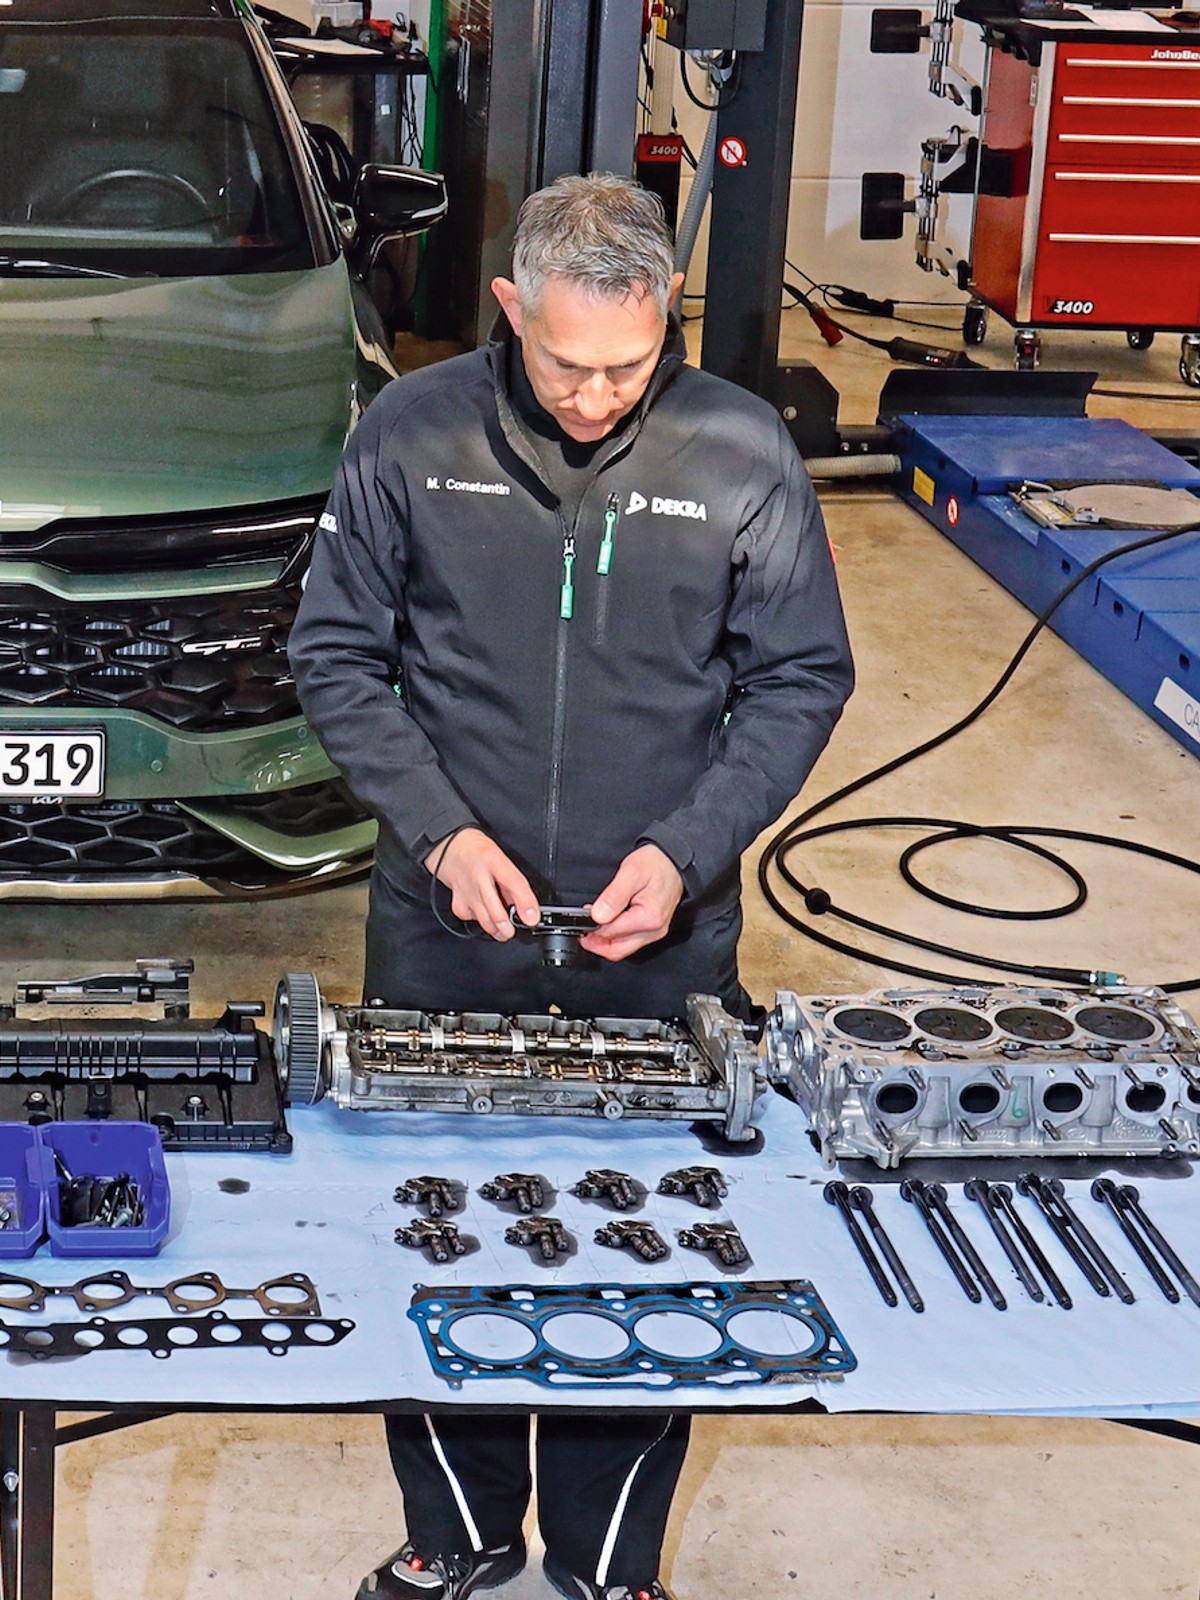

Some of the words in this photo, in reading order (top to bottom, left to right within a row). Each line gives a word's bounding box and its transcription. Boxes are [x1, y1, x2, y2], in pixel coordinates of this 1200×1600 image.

[1151, 49, 1200, 60] JohnBe
[426, 477, 441, 490] M.
[445, 478, 510, 495] Constantin
[651, 496, 707, 522] DEKRA
